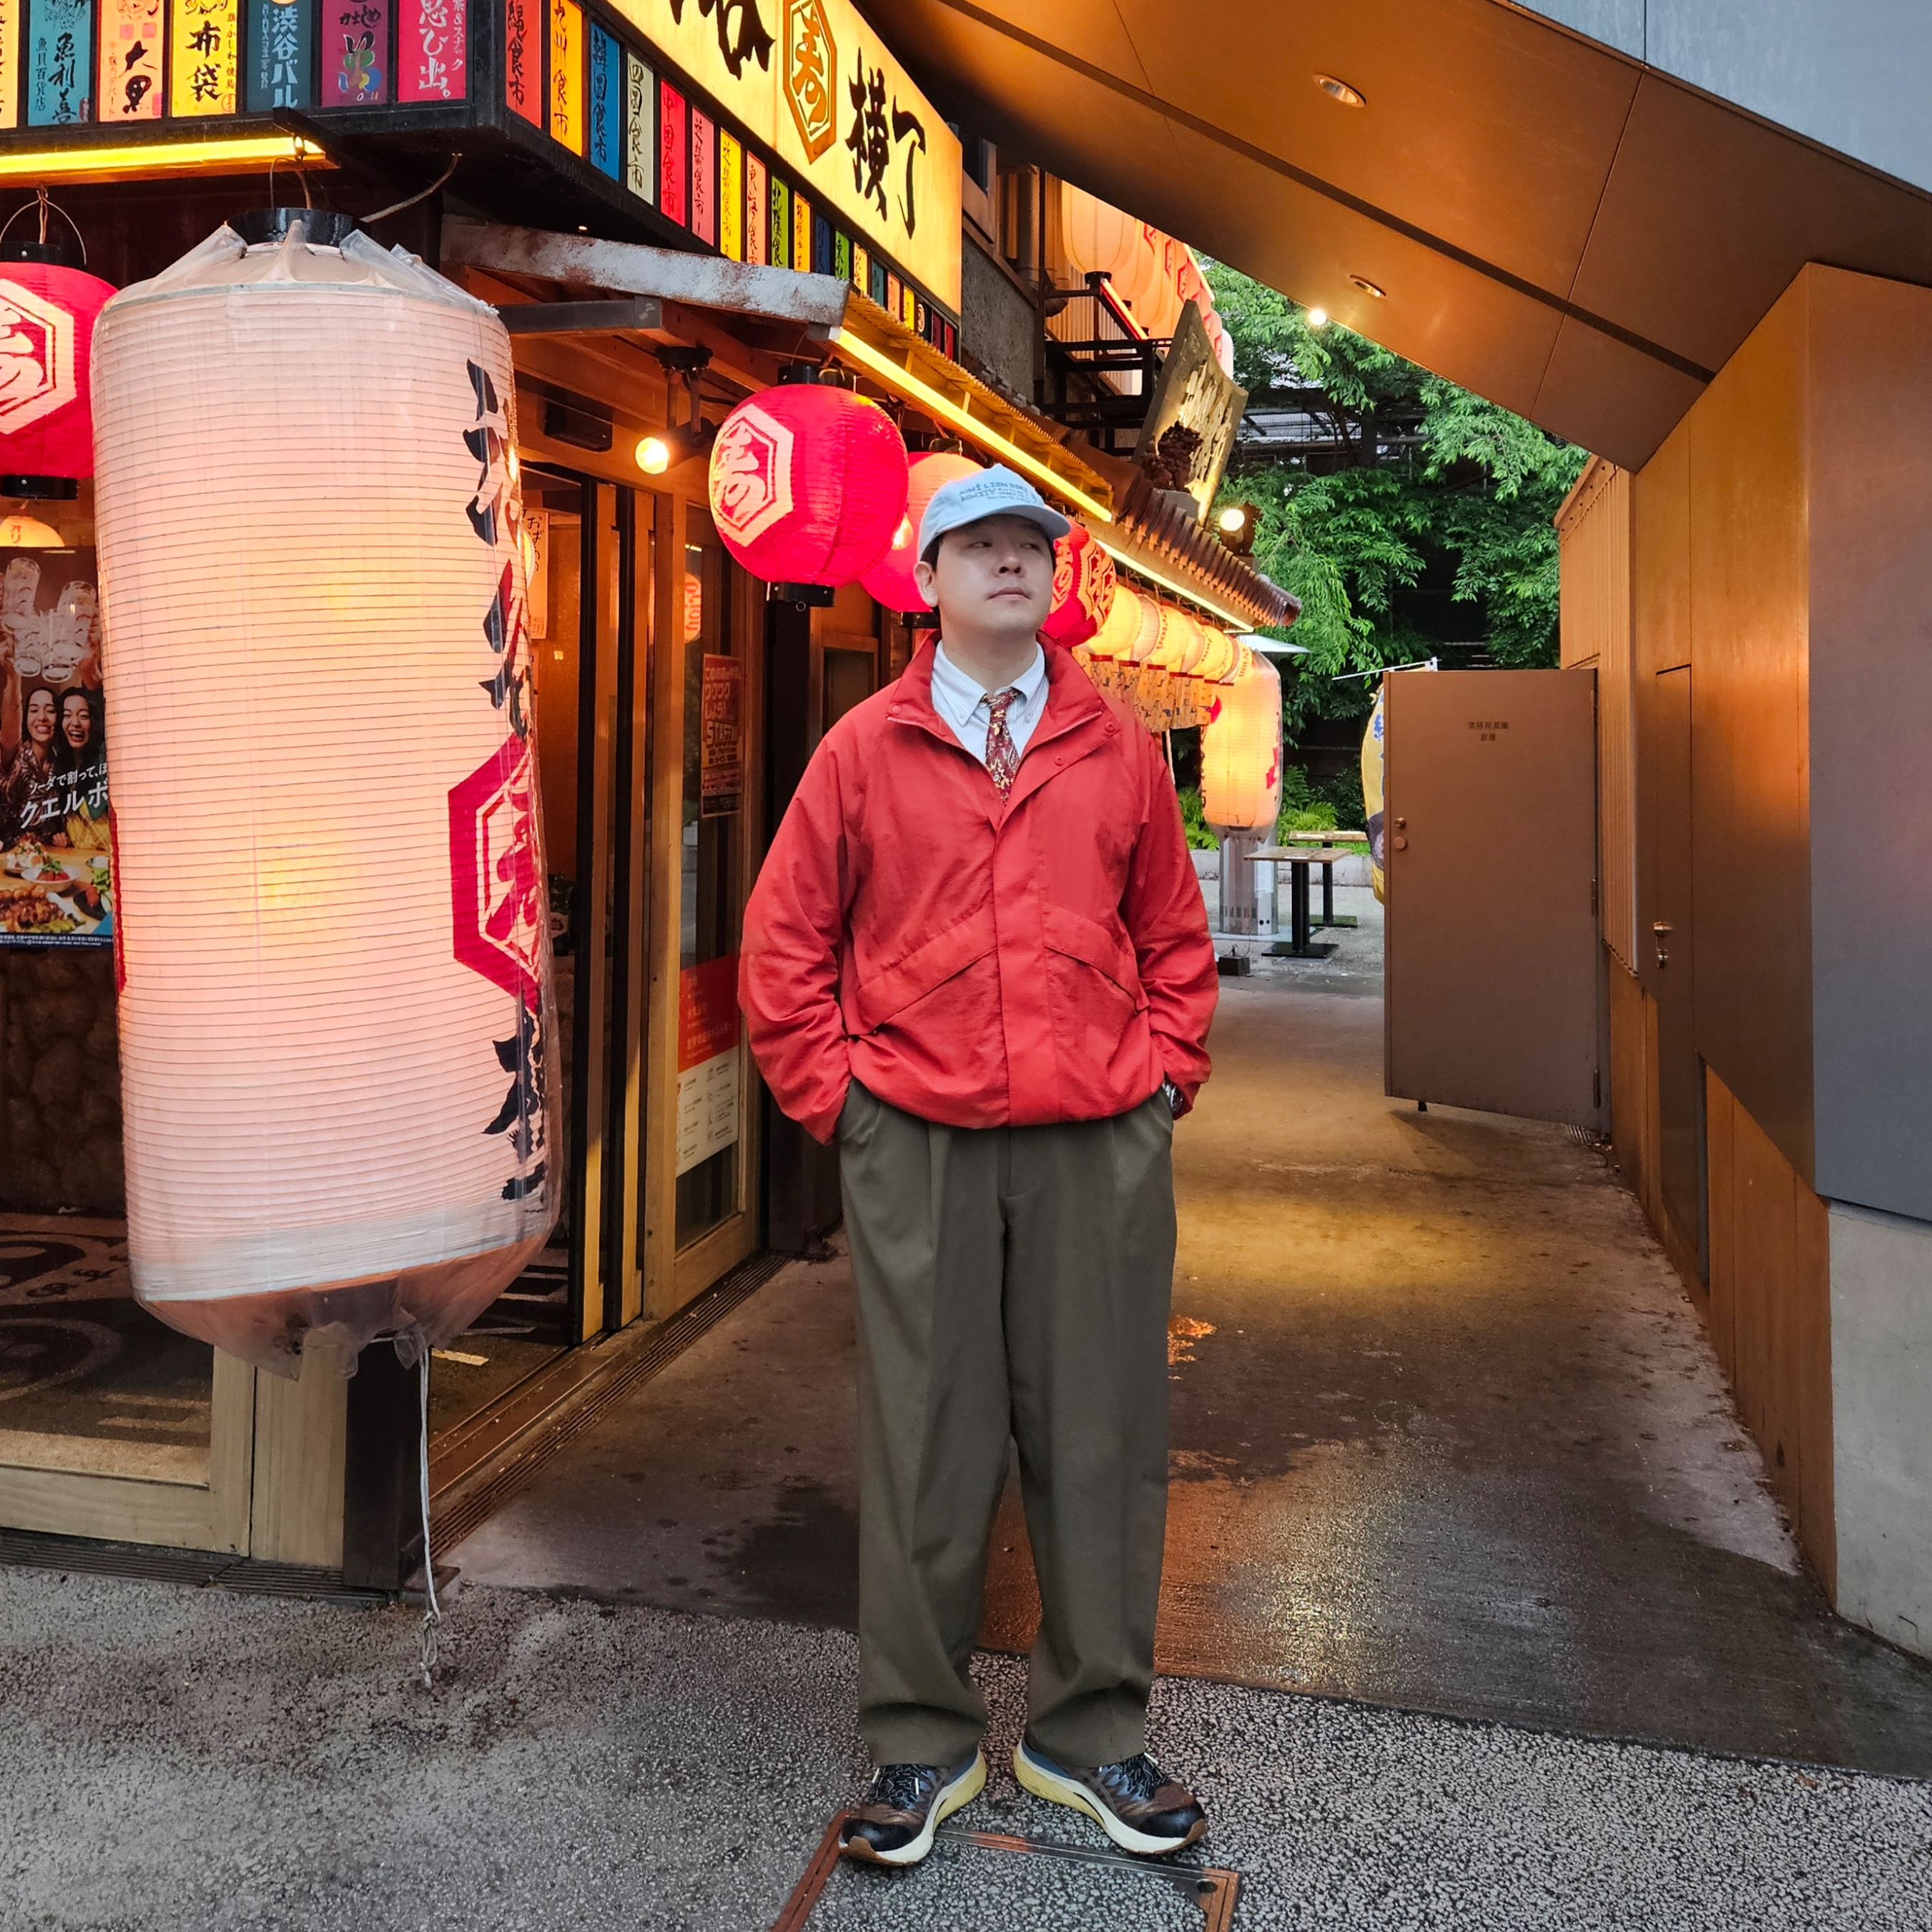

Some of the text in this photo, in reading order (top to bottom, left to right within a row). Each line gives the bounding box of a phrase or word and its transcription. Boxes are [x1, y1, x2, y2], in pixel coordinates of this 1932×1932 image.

[186, 20, 222, 102] 布袋
[271, 6, 298, 107] 渋谷バル
[845, 47, 927, 240] 横丁
[20, 778, 108, 829] クエルボ
